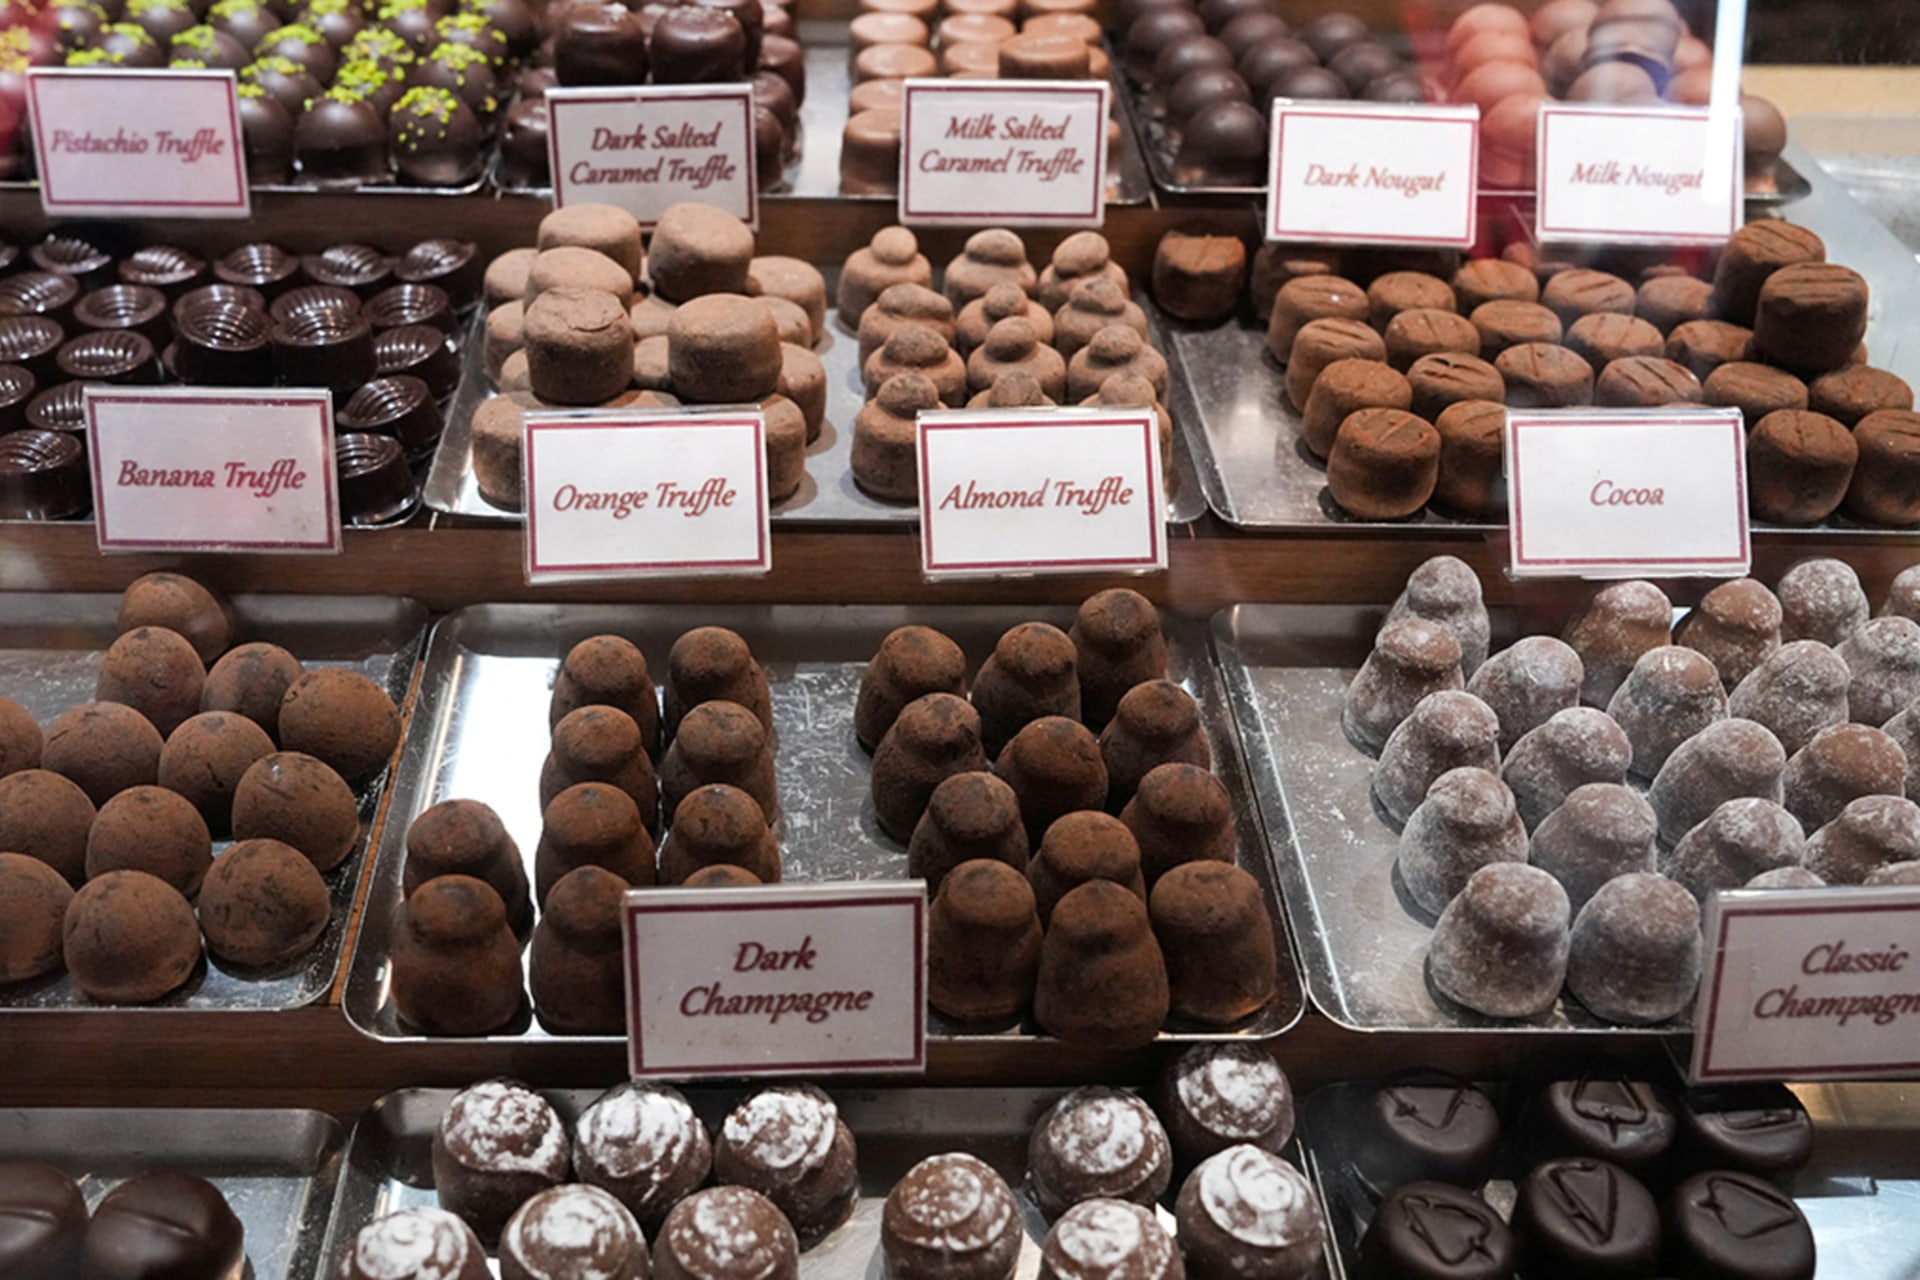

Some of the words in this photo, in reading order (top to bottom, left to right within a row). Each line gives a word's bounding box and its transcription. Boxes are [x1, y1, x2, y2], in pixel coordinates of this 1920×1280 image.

[51, 129, 149, 154] Pistachio
[155, 129, 225, 163] Truffle
[592, 124, 648, 152] Dark
[652, 122, 723, 150] Salted
[945, 114, 997, 142] Milk
[1000, 115, 1072, 143] Salted
[569, 157, 665, 186] Caramel
[669, 155, 738, 190] Truffle
[919, 147, 1014, 174] Caramel
[1018, 148, 1086, 182] Truffle
[1303, 164, 1359, 189] Dark
[1364, 168, 1446, 198] Nougat
[1569, 161, 1622, 187] Milk
[1625, 165, 1704, 195] Nougat
[118, 460, 217, 490] Banana
[224, 459, 308, 499] Truffle
[1590, 480, 1666, 508] Cocoa
[553, 484, 650, 521] Orange
[657, 477, 738, 519] Truffle
[939, 478, 1051, 512] Almond
[1055, 476, 1136, 518] Truffle
[734, 936, 818, 976] Dark
[1802, 939, 1911, 977] Classic
[680, 981, 876, 1027] Champagne
[1754, 985, 1920, 1027] Champagn
